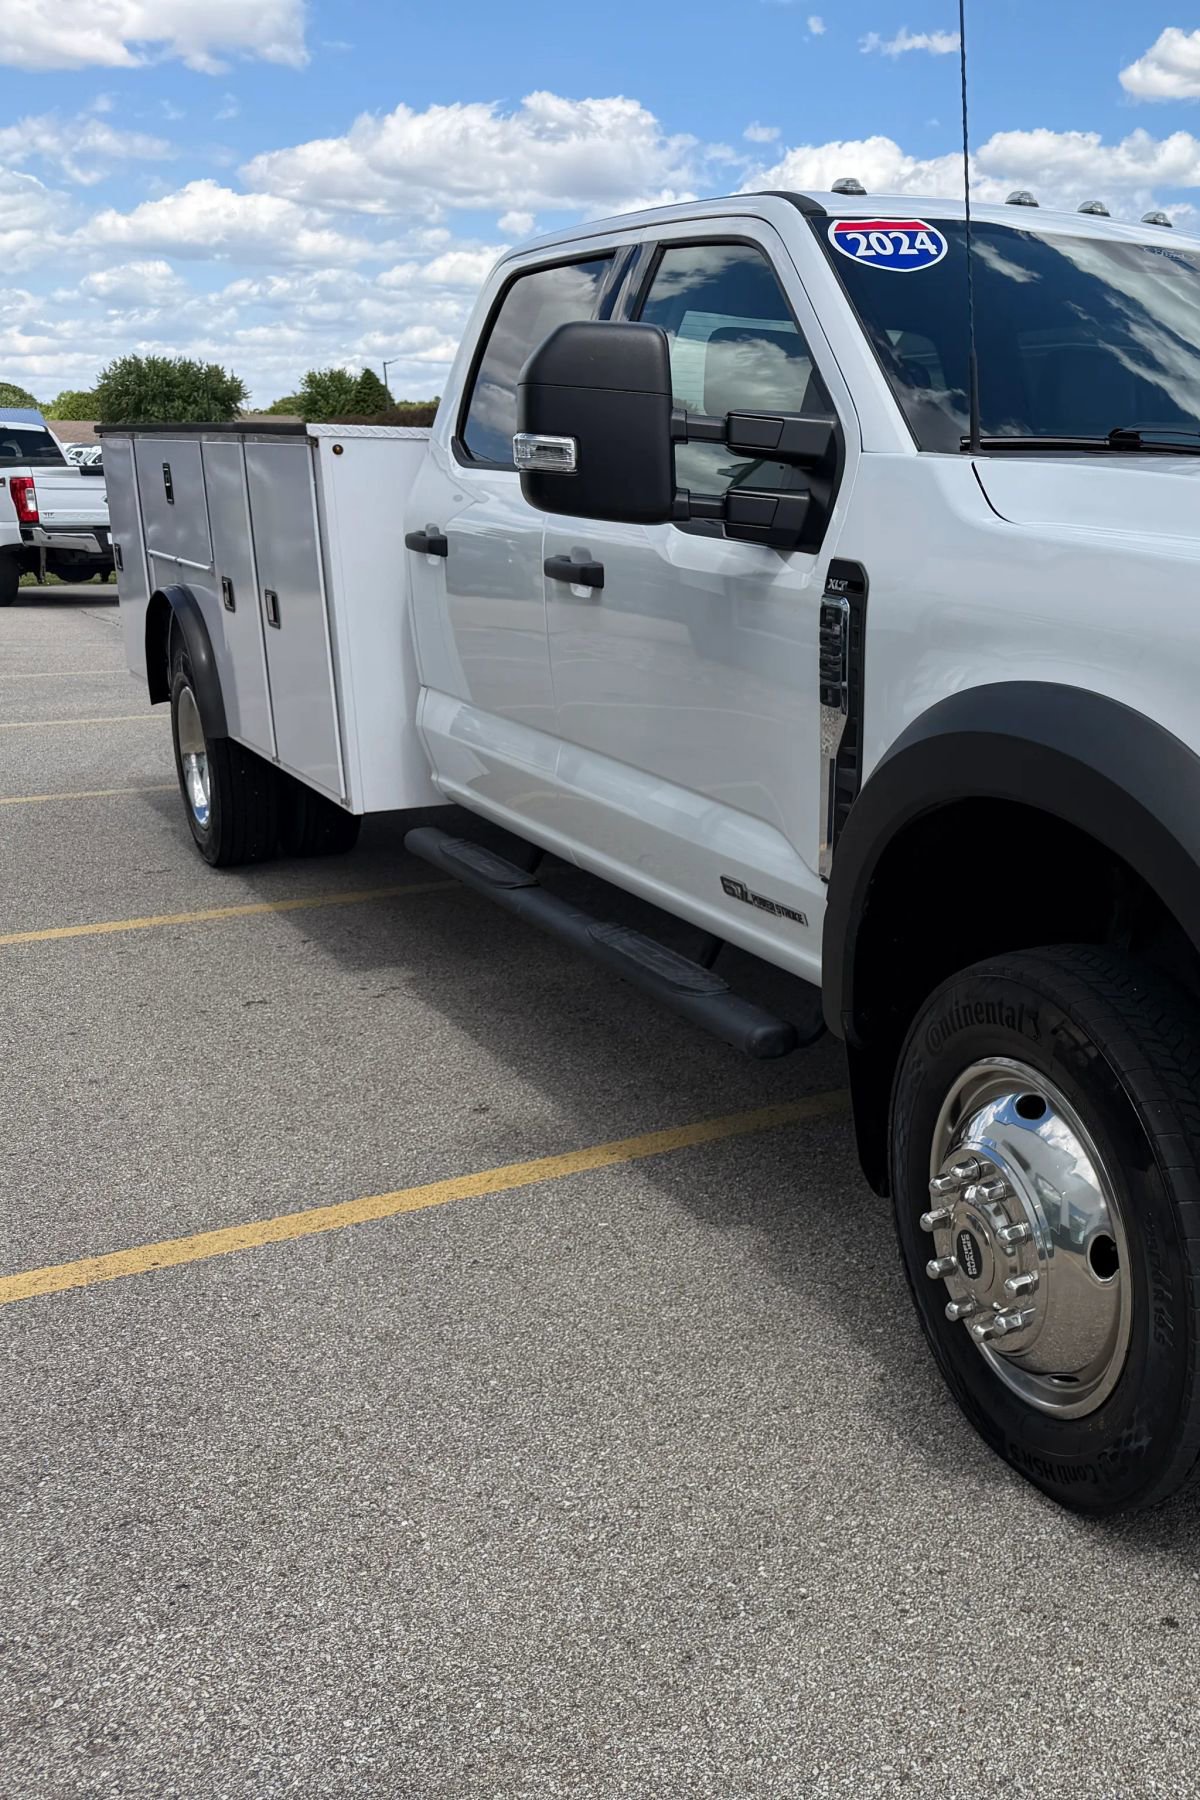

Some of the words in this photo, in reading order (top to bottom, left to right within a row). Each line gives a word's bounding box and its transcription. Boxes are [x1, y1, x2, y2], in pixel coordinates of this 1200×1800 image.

[846, 231, 938, 257] 2024
[827, 578, 849, 592] XLT
[925, 996, 1025, 1056] Continental
[960, 1233, 973, 1276] PACIFIC
